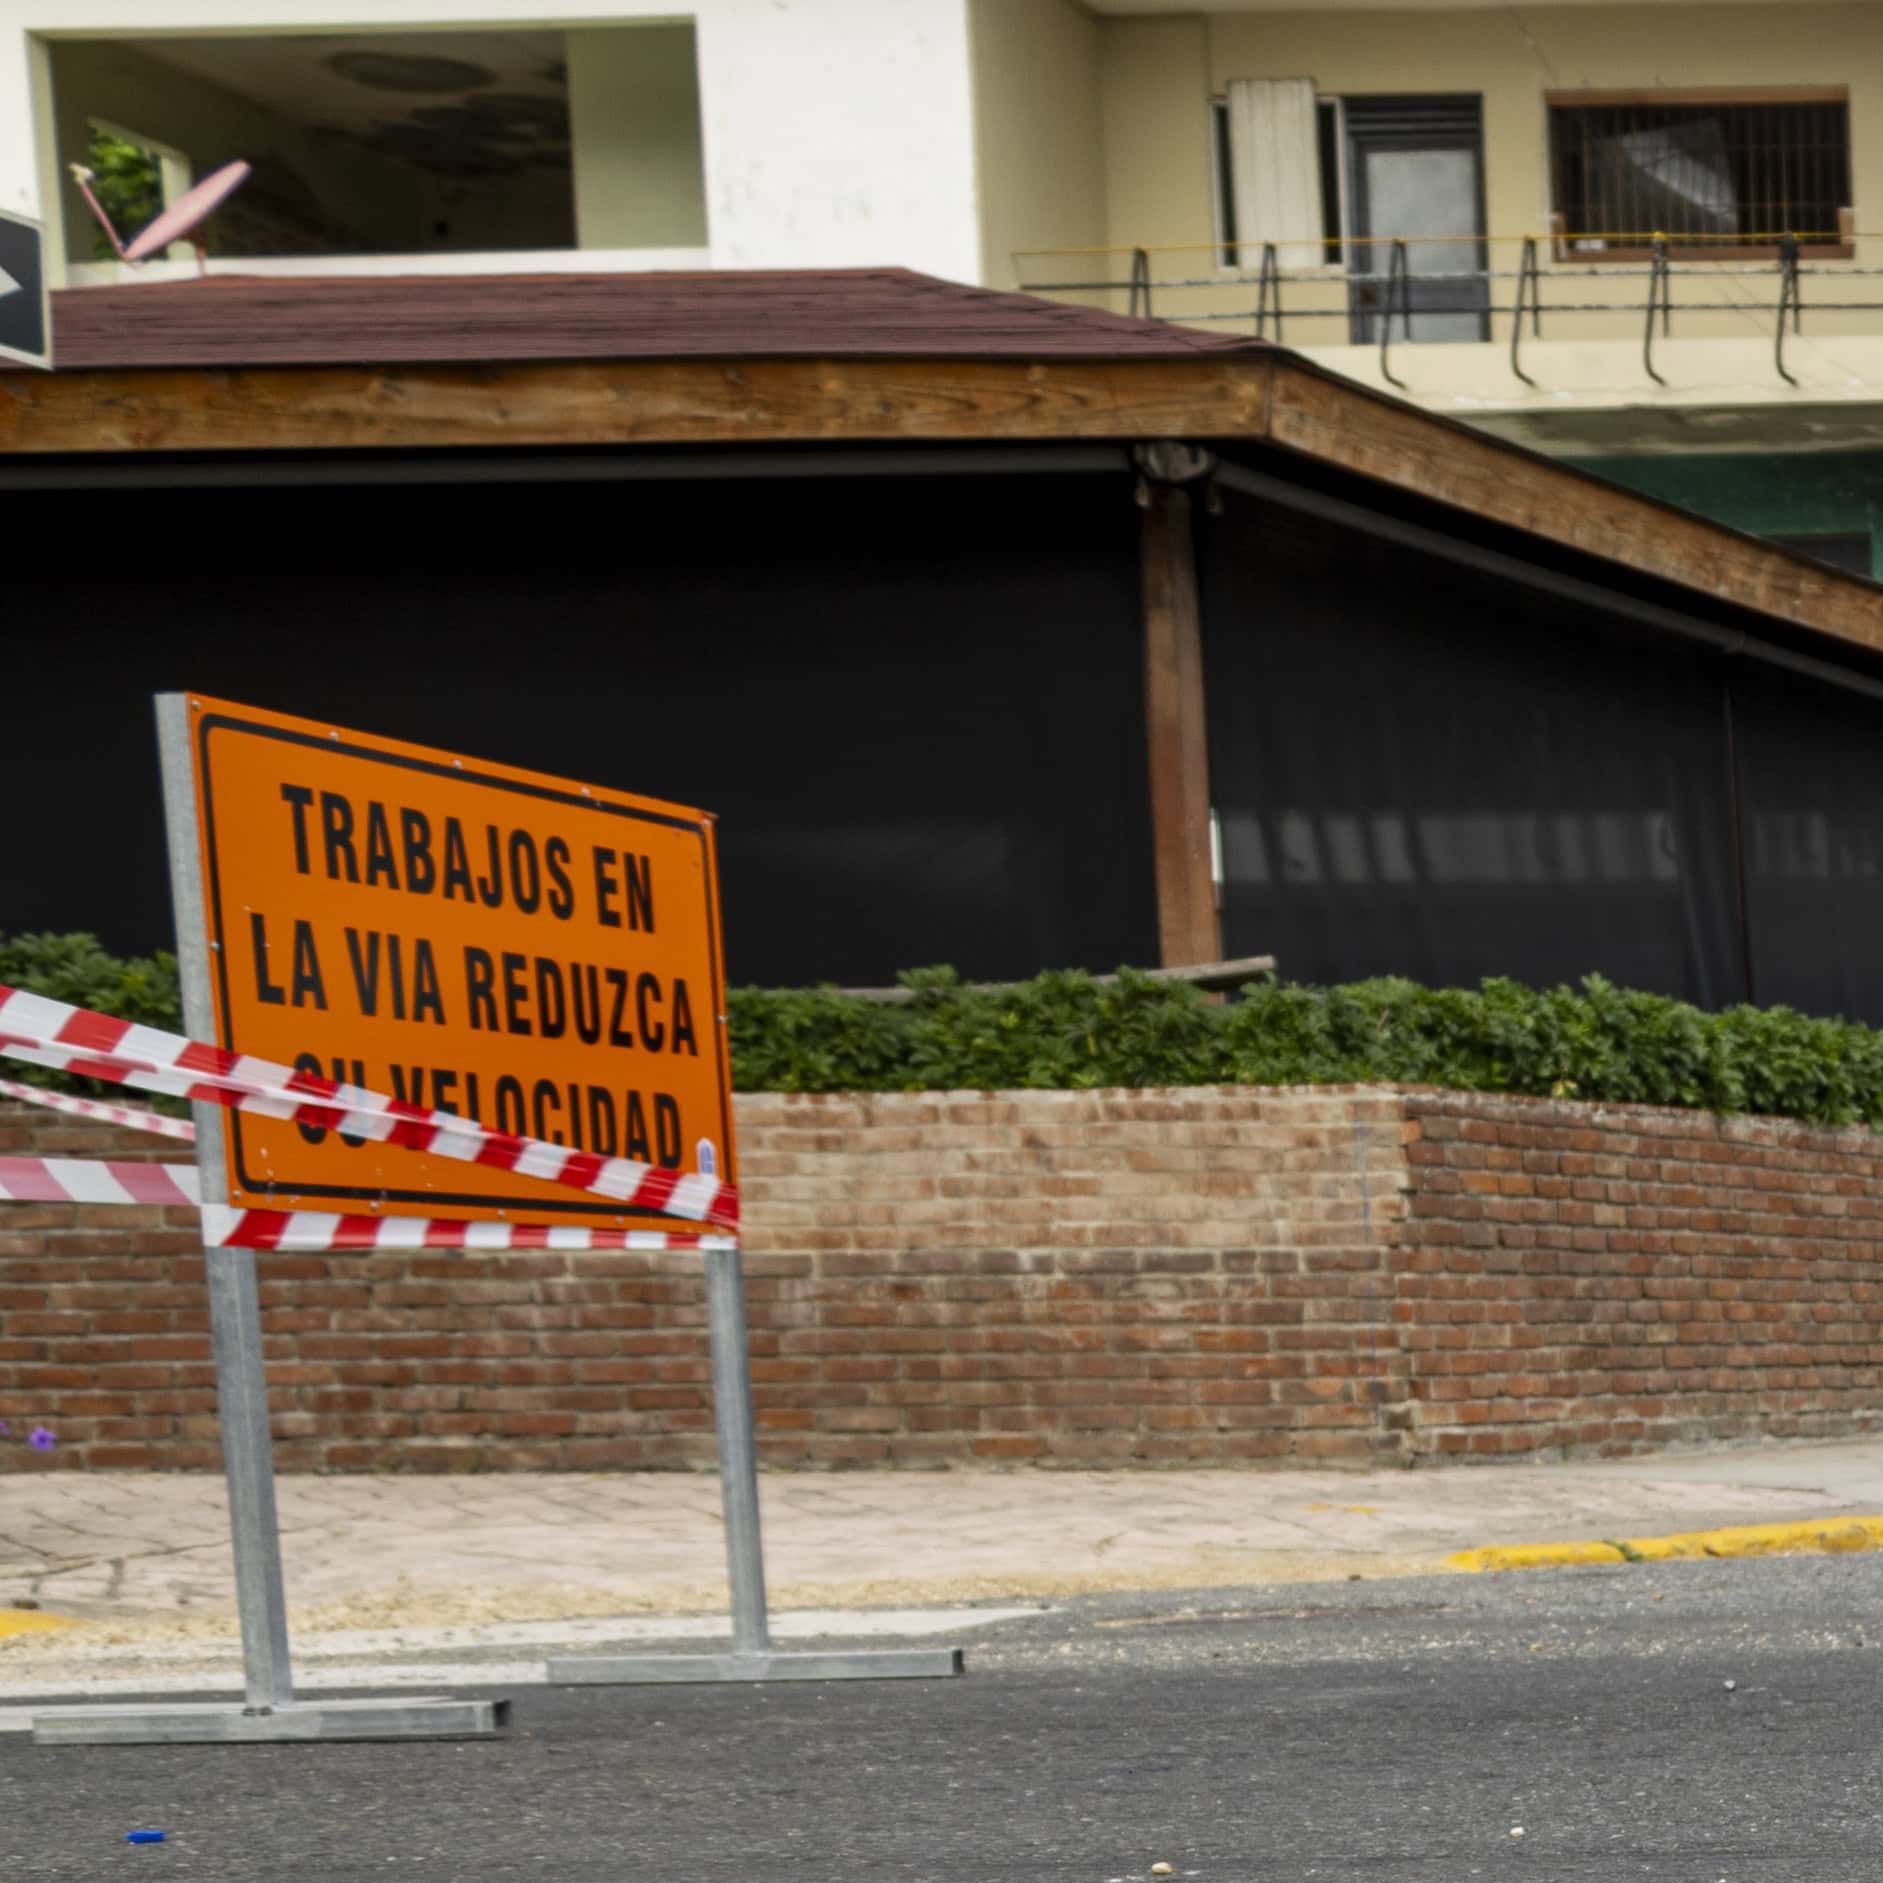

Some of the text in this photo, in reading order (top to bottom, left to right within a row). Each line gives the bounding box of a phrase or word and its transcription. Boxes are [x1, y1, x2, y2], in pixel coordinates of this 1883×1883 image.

[280, 782, 655, 934] TRABAJOS EN
[250, 912, 698, 1057] LA VIA REDUZCA
